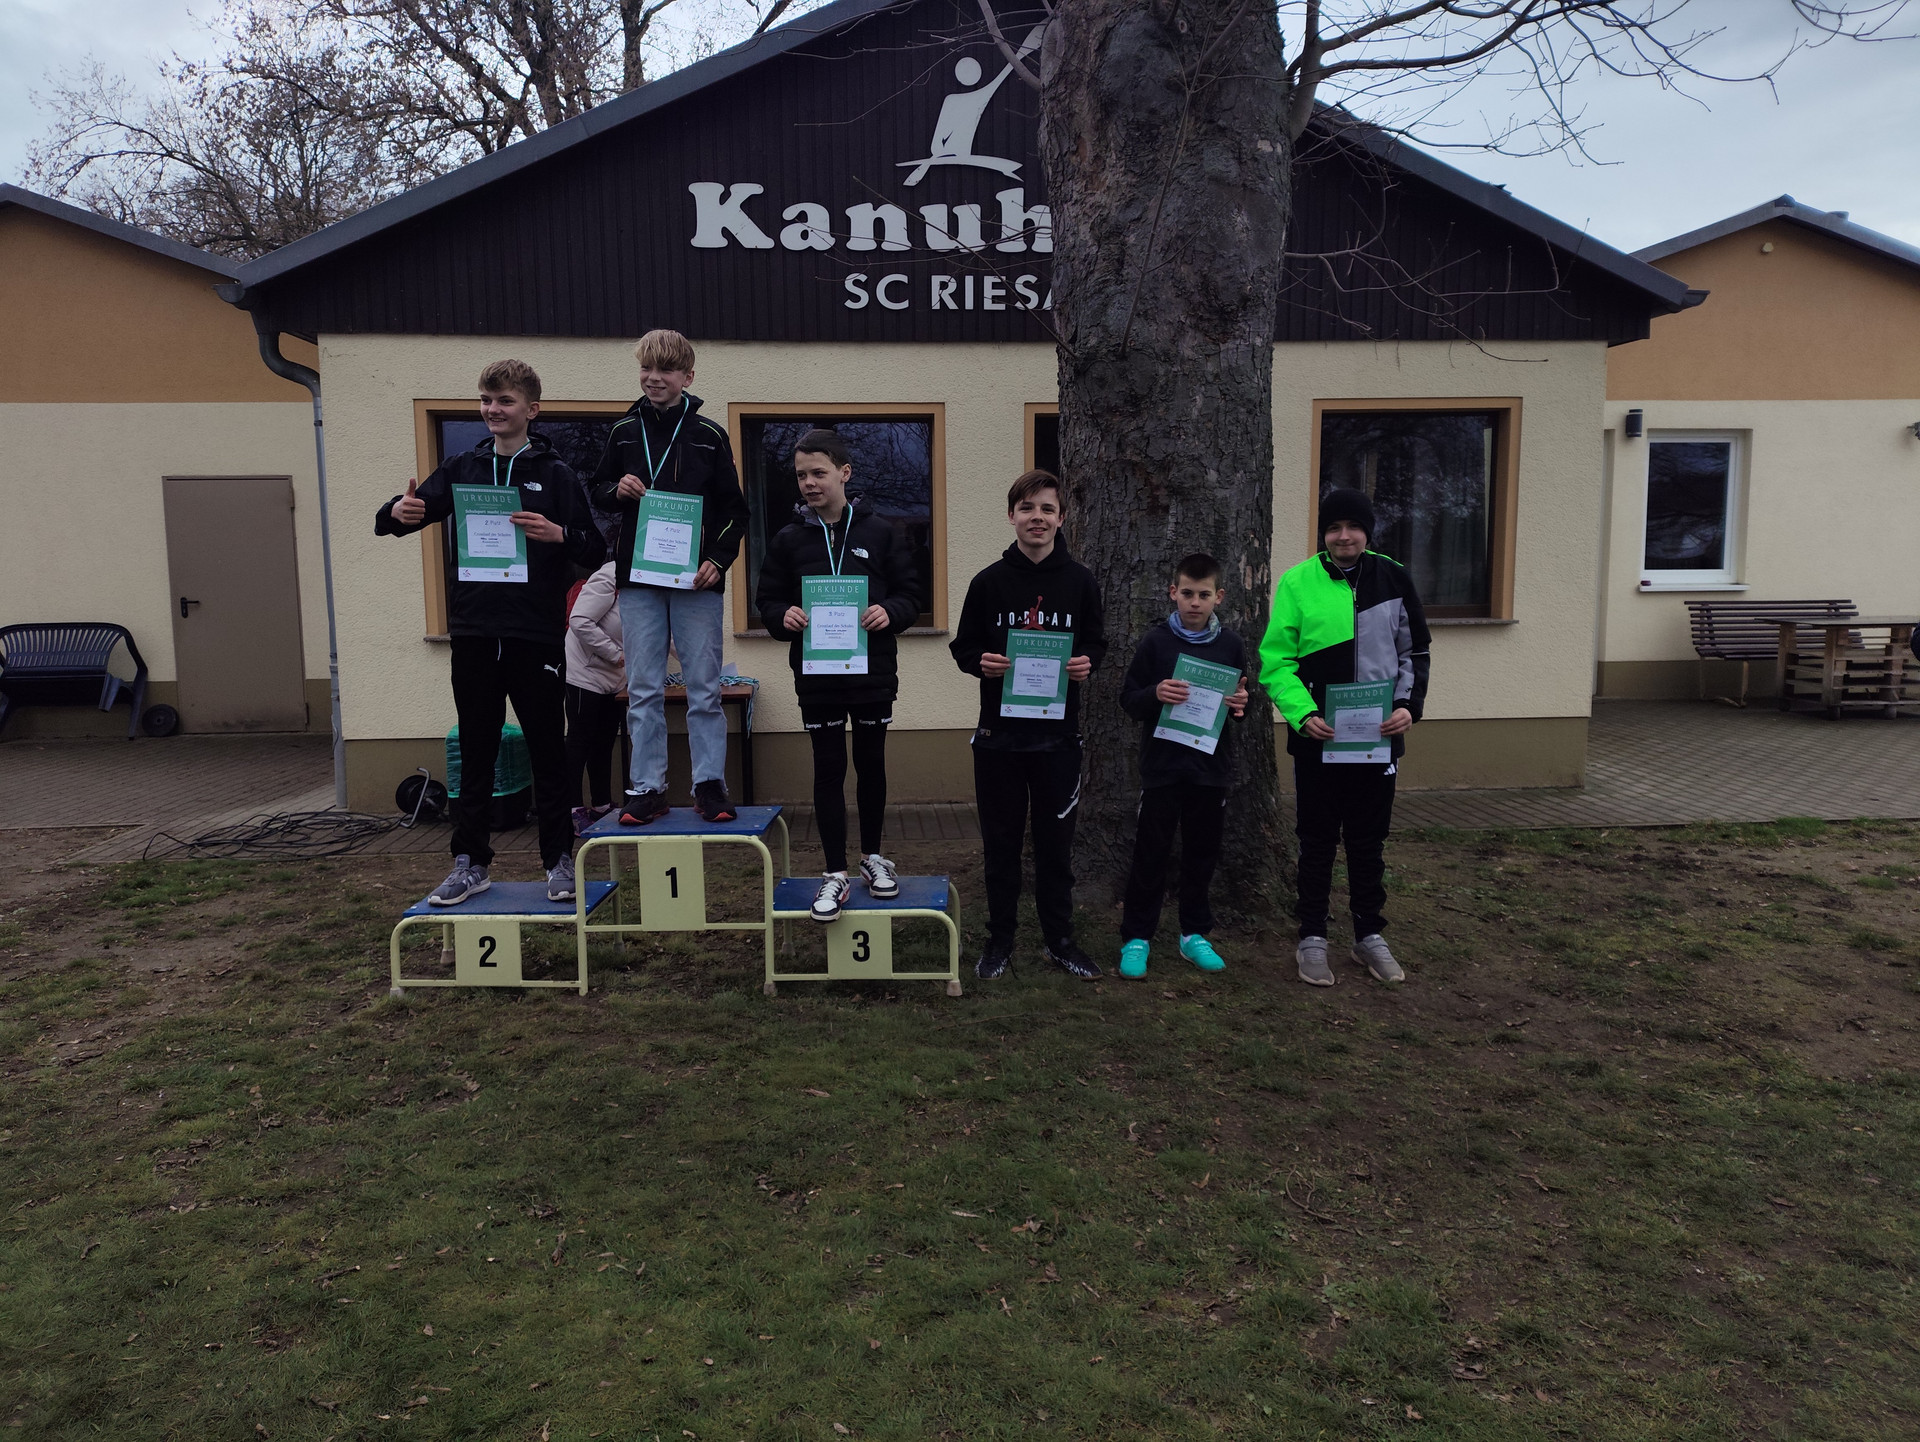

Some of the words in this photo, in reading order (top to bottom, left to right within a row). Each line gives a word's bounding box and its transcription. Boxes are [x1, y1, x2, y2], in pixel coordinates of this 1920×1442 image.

[844, 272, 909, 311] SC
[931, 273, 1054, 311] RIES
[462, 494, 512, 504] URKUNDE
[649, 499, 695, 513] URKUNDE
[810, 585, 859, 594] URKUNDE
[996, 610, 1072, 628] JORDAN
[1016, 639, 1064, 649] URKUNDE
[1184, 665, 1231, 683] URKUNDE
[1335, 688, 1384, 700] URKUNDE
[664, 866, 679, 899] 1
[477, 935, 498, 969] 2
[851, 929, 871, 963] 3
